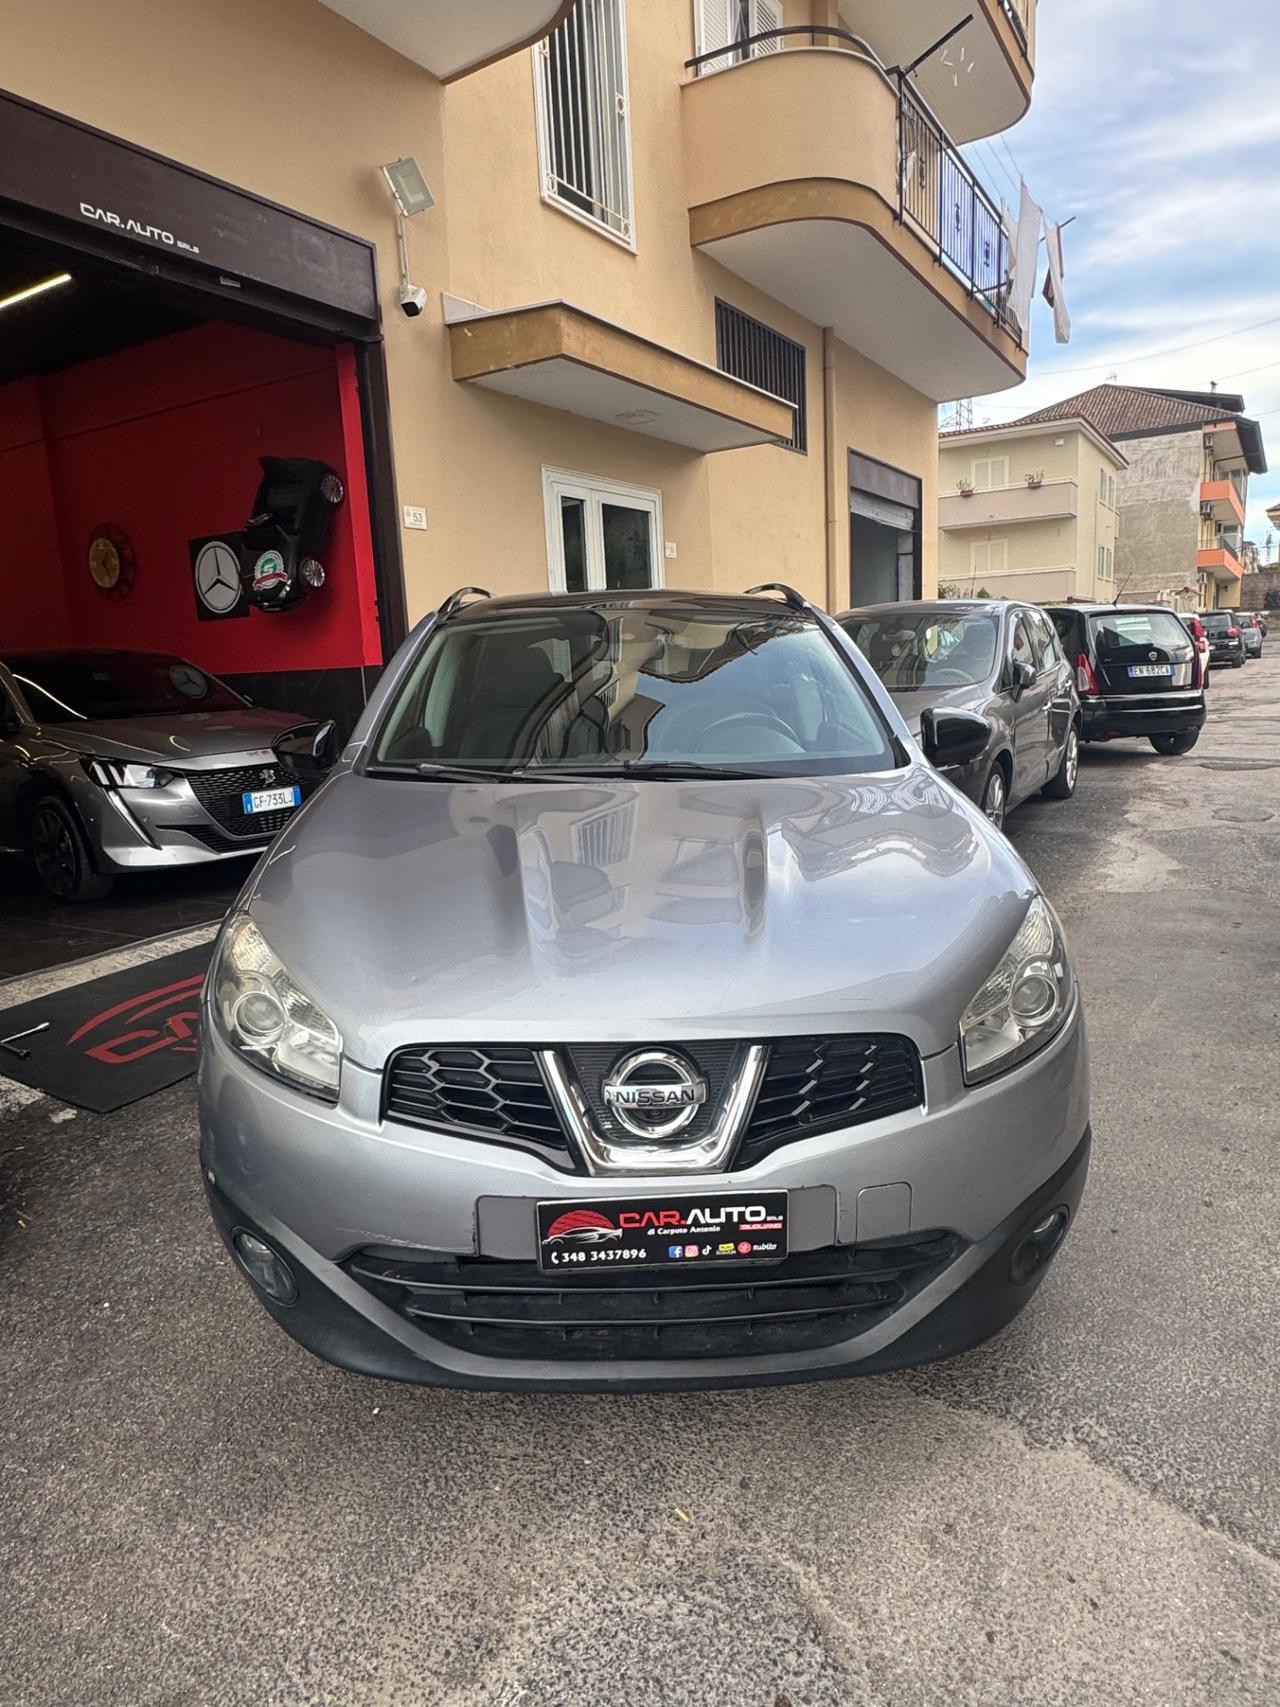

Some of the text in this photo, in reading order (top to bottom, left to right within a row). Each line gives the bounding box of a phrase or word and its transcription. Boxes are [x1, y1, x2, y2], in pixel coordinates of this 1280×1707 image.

[79, 201, 175, 245] CAR.AUTO
[615, 1088, 695, 1105] NISSAN
[619, 1205, 767, 1228] CAR.AUTO
[647, 1228, 656, 1236] di
[689, 1225, 721, 1234] Antonio
[562, 1248, 647, 1263] 348 3437896
